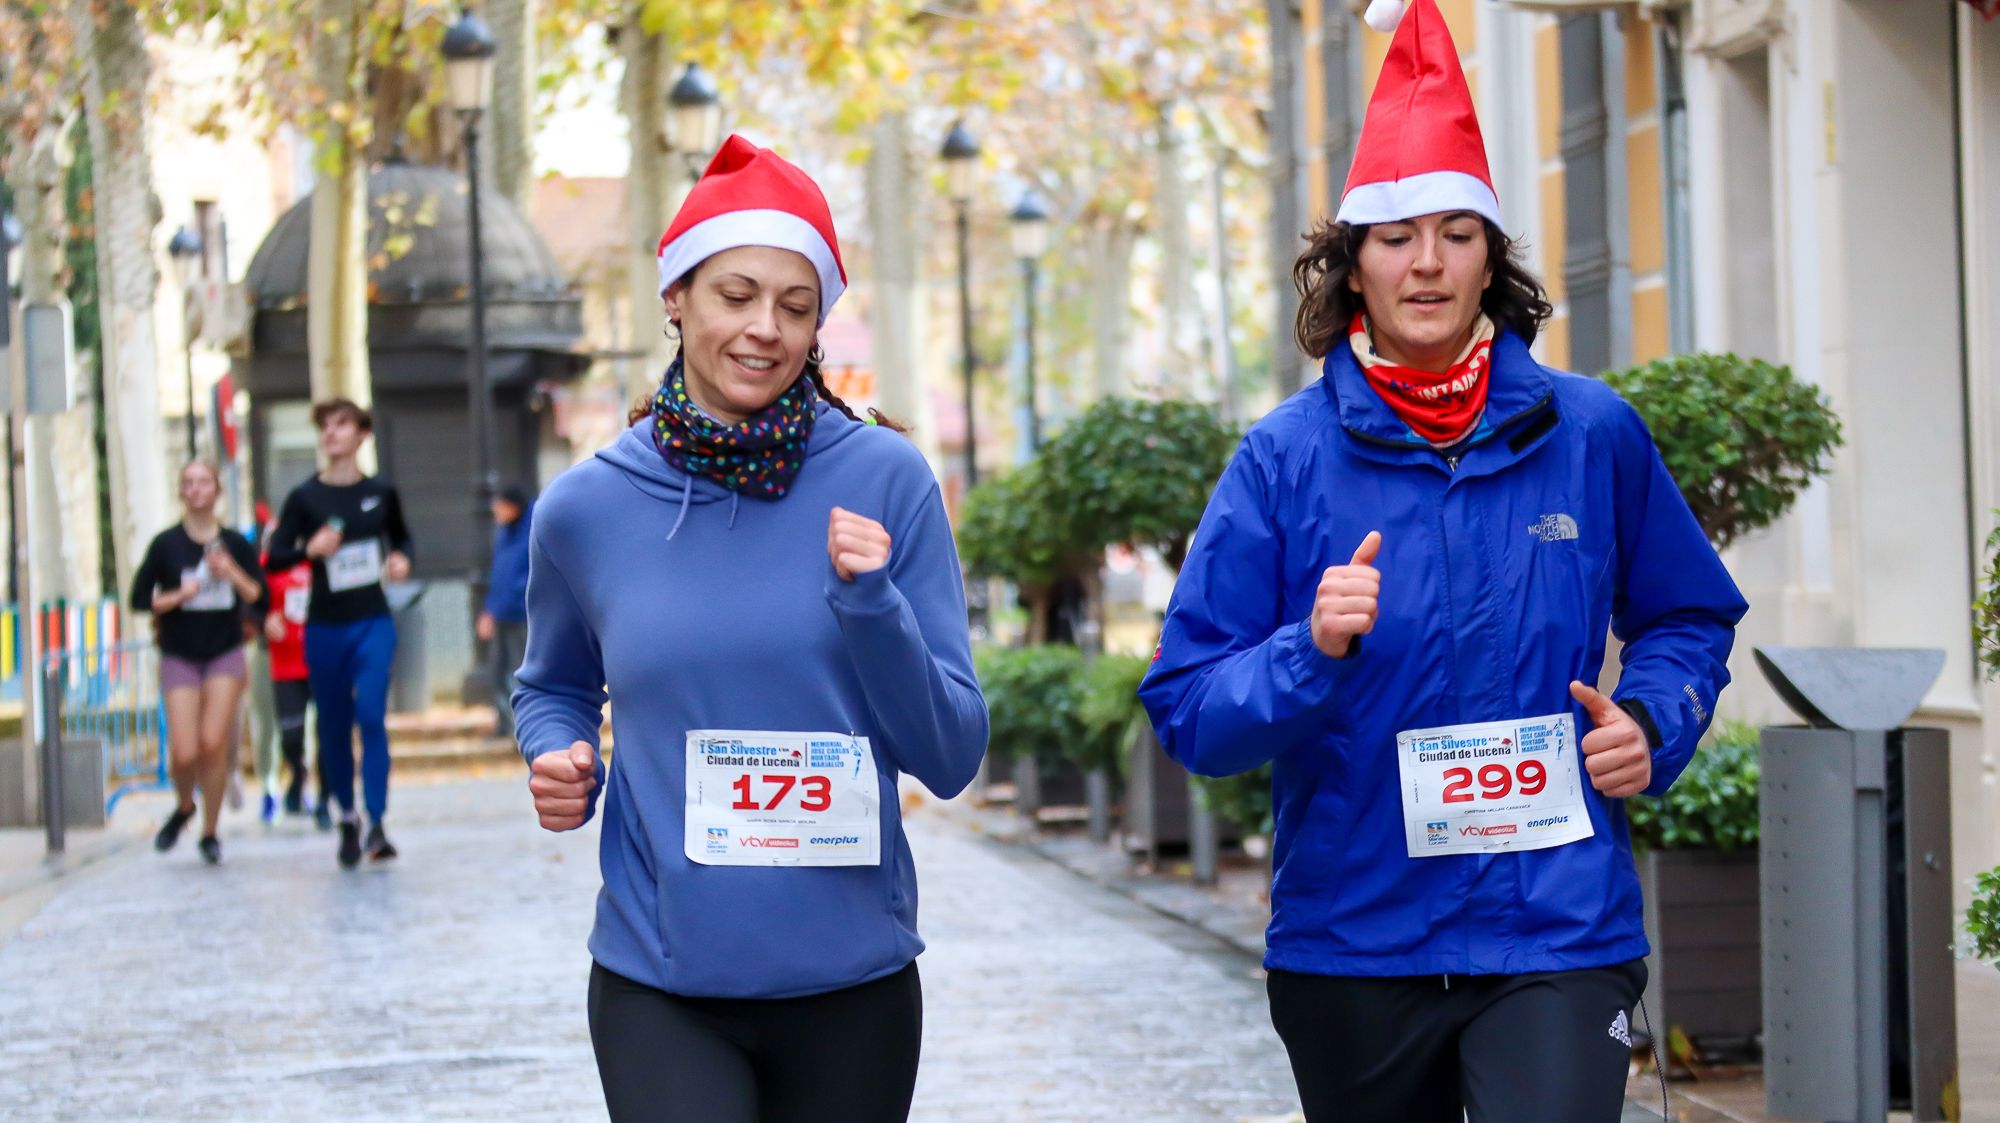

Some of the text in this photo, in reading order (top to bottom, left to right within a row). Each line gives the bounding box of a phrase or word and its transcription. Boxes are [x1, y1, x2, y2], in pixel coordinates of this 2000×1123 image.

[1540, 514, 1558, 526] THE
[707, 744, 728, 755] San
[730, 744, 777, 755] Silvestre
[1419, 740, 1439, 752] San
[1441, 737, 1488, 750] Silvestre
[707, 755, 800, 768] Ciudad de Lucena
[1419, 747, 1512, 763] Ciudad de Lucena
[1442, 759, 1547, 804] 299
[732, 774, 832, 812] 173
[1527, 815, 1568, 828] enerplus
[810, 835, 859, 846] enerplus
